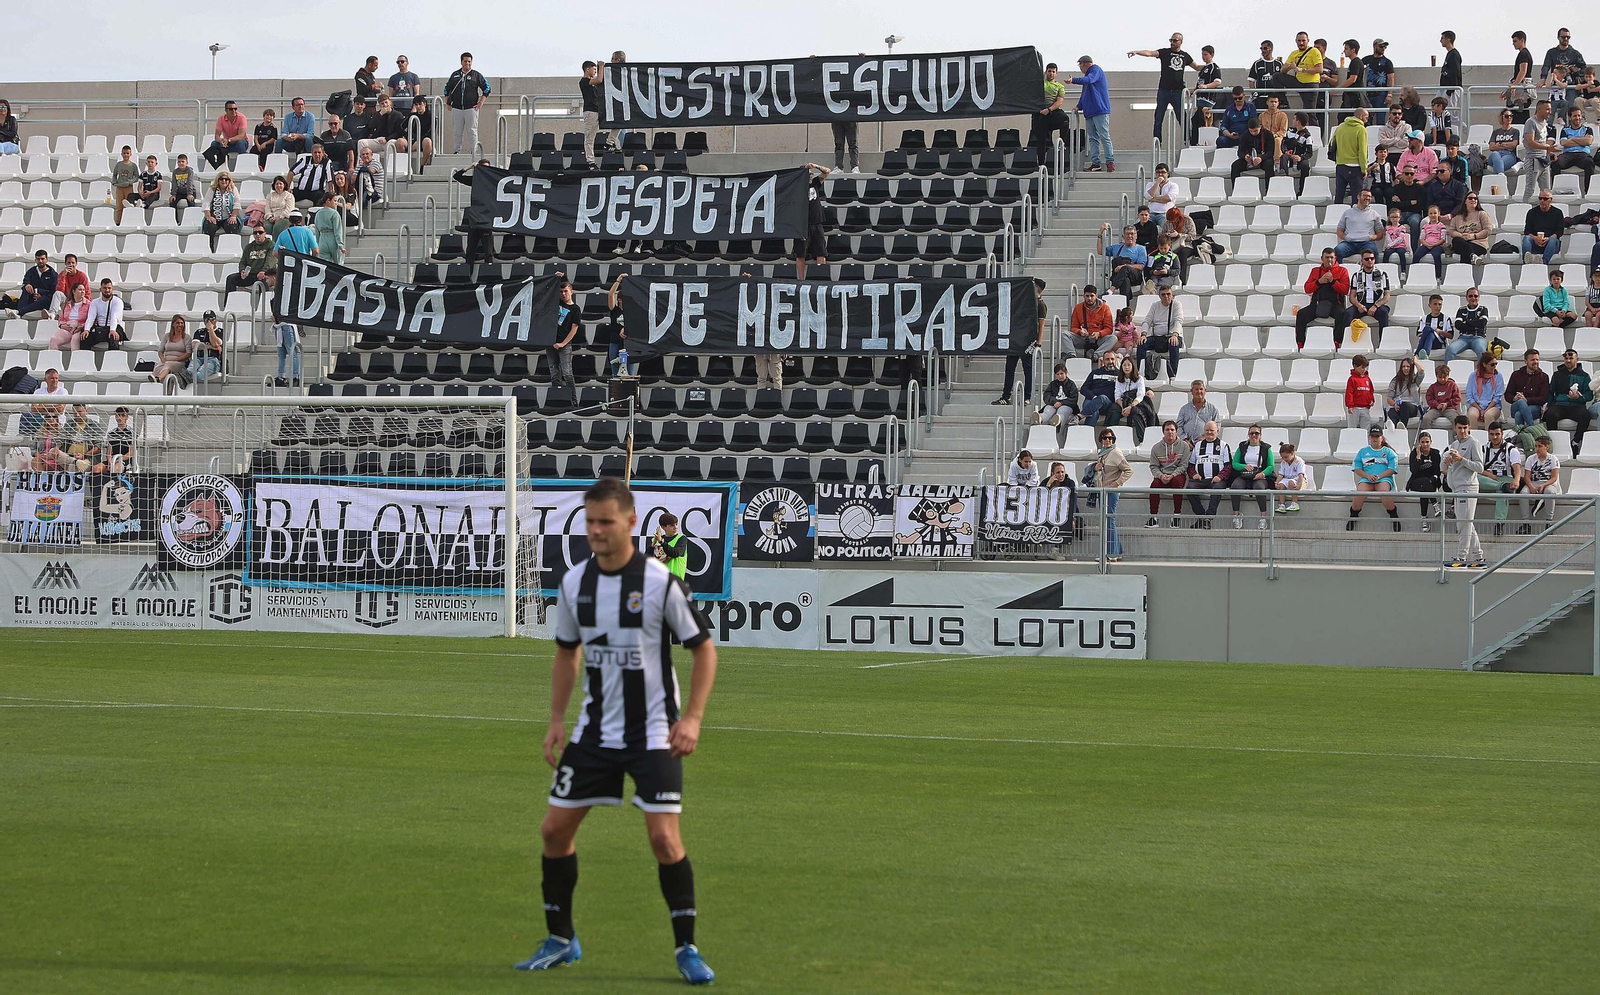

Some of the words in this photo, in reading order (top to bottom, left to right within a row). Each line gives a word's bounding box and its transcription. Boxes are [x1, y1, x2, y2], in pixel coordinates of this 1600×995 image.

[604, 61, 797, 121] NUESTRO
[823, 54, 994, 115] ESCUDO
[493, 175, 551, 229] SE
[575, 174, 777, 235] RESPETA
[648, 283, 708, 346] DE
[737, 282, 1011, 350] MENTIRAS!
[16, 471, 85, 493] HIJOS
[176, 475, 229, 495] CACHORROS
[819, 483, 896, 499] ULTRAS
[746, 488, 790, 518] COLECTIVO
[790, 493, 808, 520] DOCE
[162, 514, 170, 523] 19
[234, 513, 242, 523] 12
[8, 520, 24, 542] DE
[26, 521, 41, 543] LA
[754, 535, 798, 554] BALONA
[818, 545, 835, 557] NO
[836, 545, 892, 557] POLITICA
[895, 544, 903, 556] Y
[906, 544, 941, 556] NADA
[943, 544, 972, 556] MAS
[14, 595, 32, 614] EL
[39, 596, 98, 615] MONJE
[112, 597, 129, 616] EL
[135, 598, 196, 617] MONJE
[267, 595, 319, 606] SERVICIOS
[321, 596, 328, 606] Y
[414, 598, 467, 609] SERVICIOS
[469, 599, 477, 609] Y
[267, 607, 348, 619] MANTENIMIENTO
[414, 611, 498, 621] MANTENIMIENTO
[826, 615, 964, 646] LOTUS
[994, 617, 1136, 650] LOTUS
[585, 650, 642, 667] LOTUS
